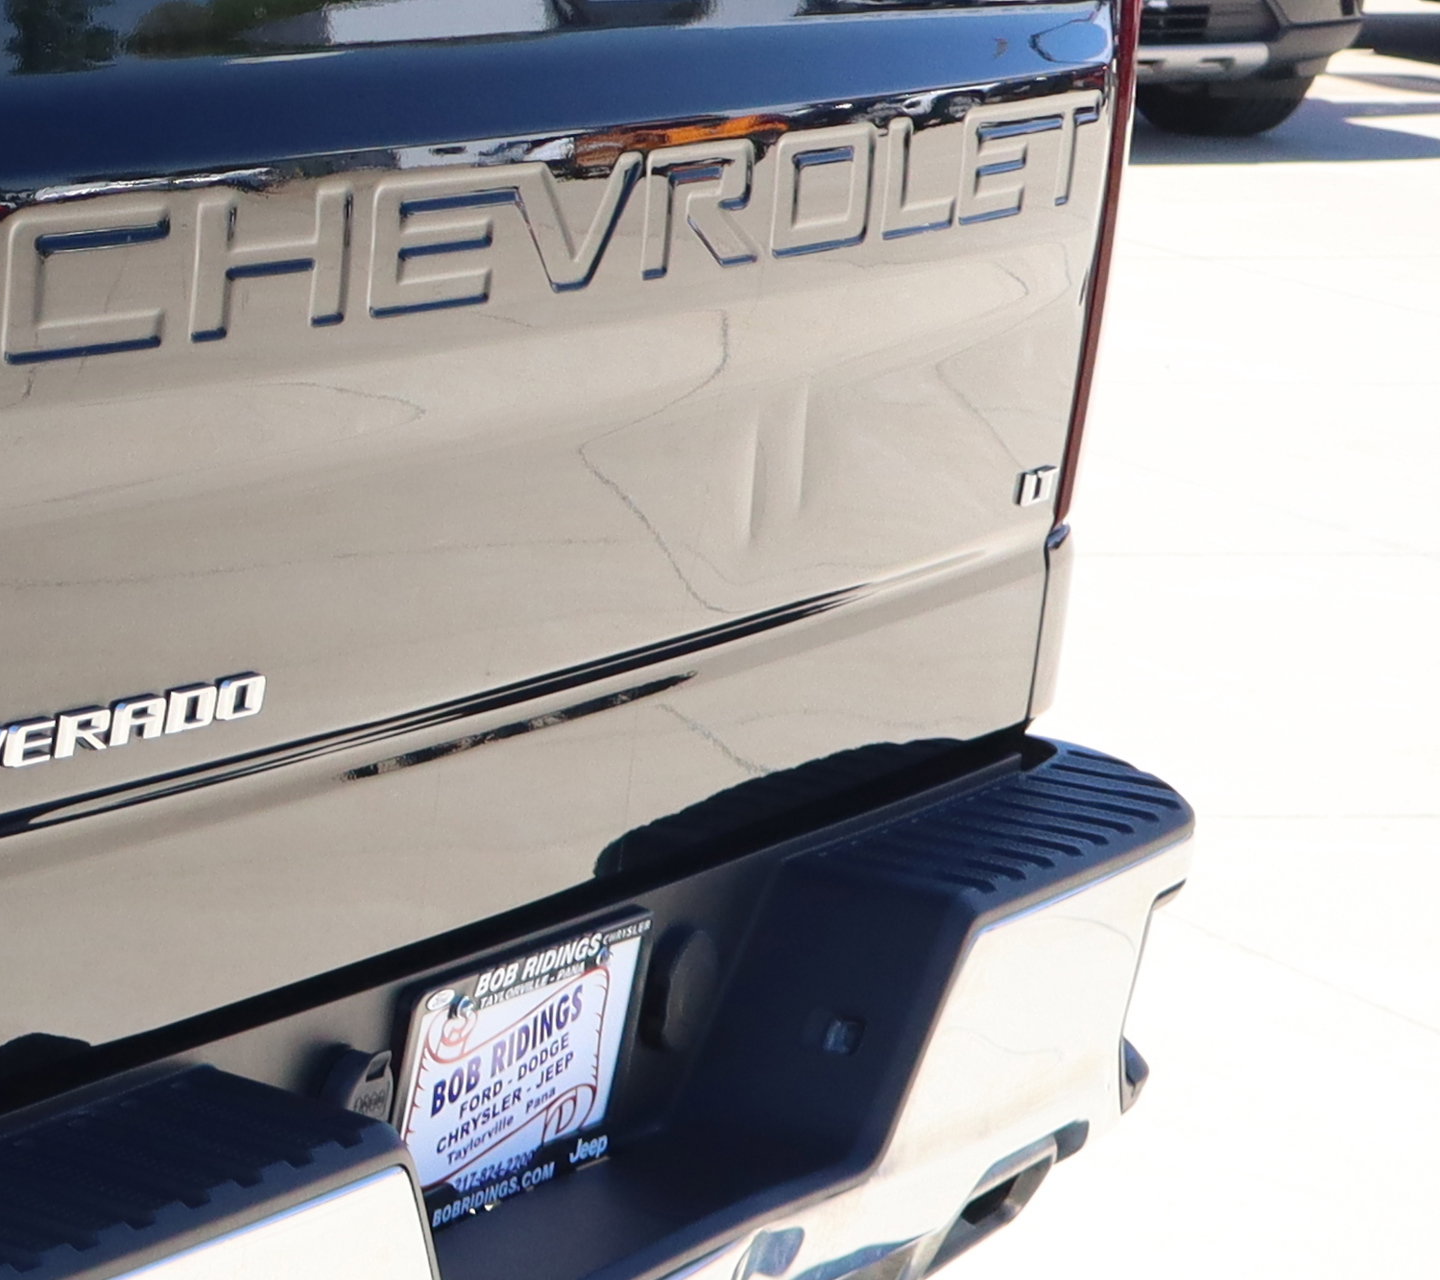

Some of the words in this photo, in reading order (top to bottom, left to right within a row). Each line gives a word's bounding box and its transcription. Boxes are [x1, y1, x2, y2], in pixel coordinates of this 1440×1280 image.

[2, 88, 1105, 366] CHEVROLET
[474, 961, 519, 998] BOB
[521, 932, 604, 981] RIDINGS
[602, 919, 652, 945] CHRYSLER
[480, 974, 549, 1010] TAYLORVILLE
[556, 961, 586, 982] PANA
[430, 1055, 483, 1118] BOB
[490, 983, 584, 1078] RIDINGS
[458, 1079, 503, 1120] FORD
[517, 1031, 570, 1080] DODGE
[435, 1087, 522, 1155] CHRYSLER
[536, 1050, 575, 1090] JEEP
[446, 1114, 515, 1166] Taylorville
[524, 1085, 557, 1115] Pana
[569, 1134, 609, 1164] Jeep
[431, 1161, 556, 1228] BOBRIDINGS.COM
